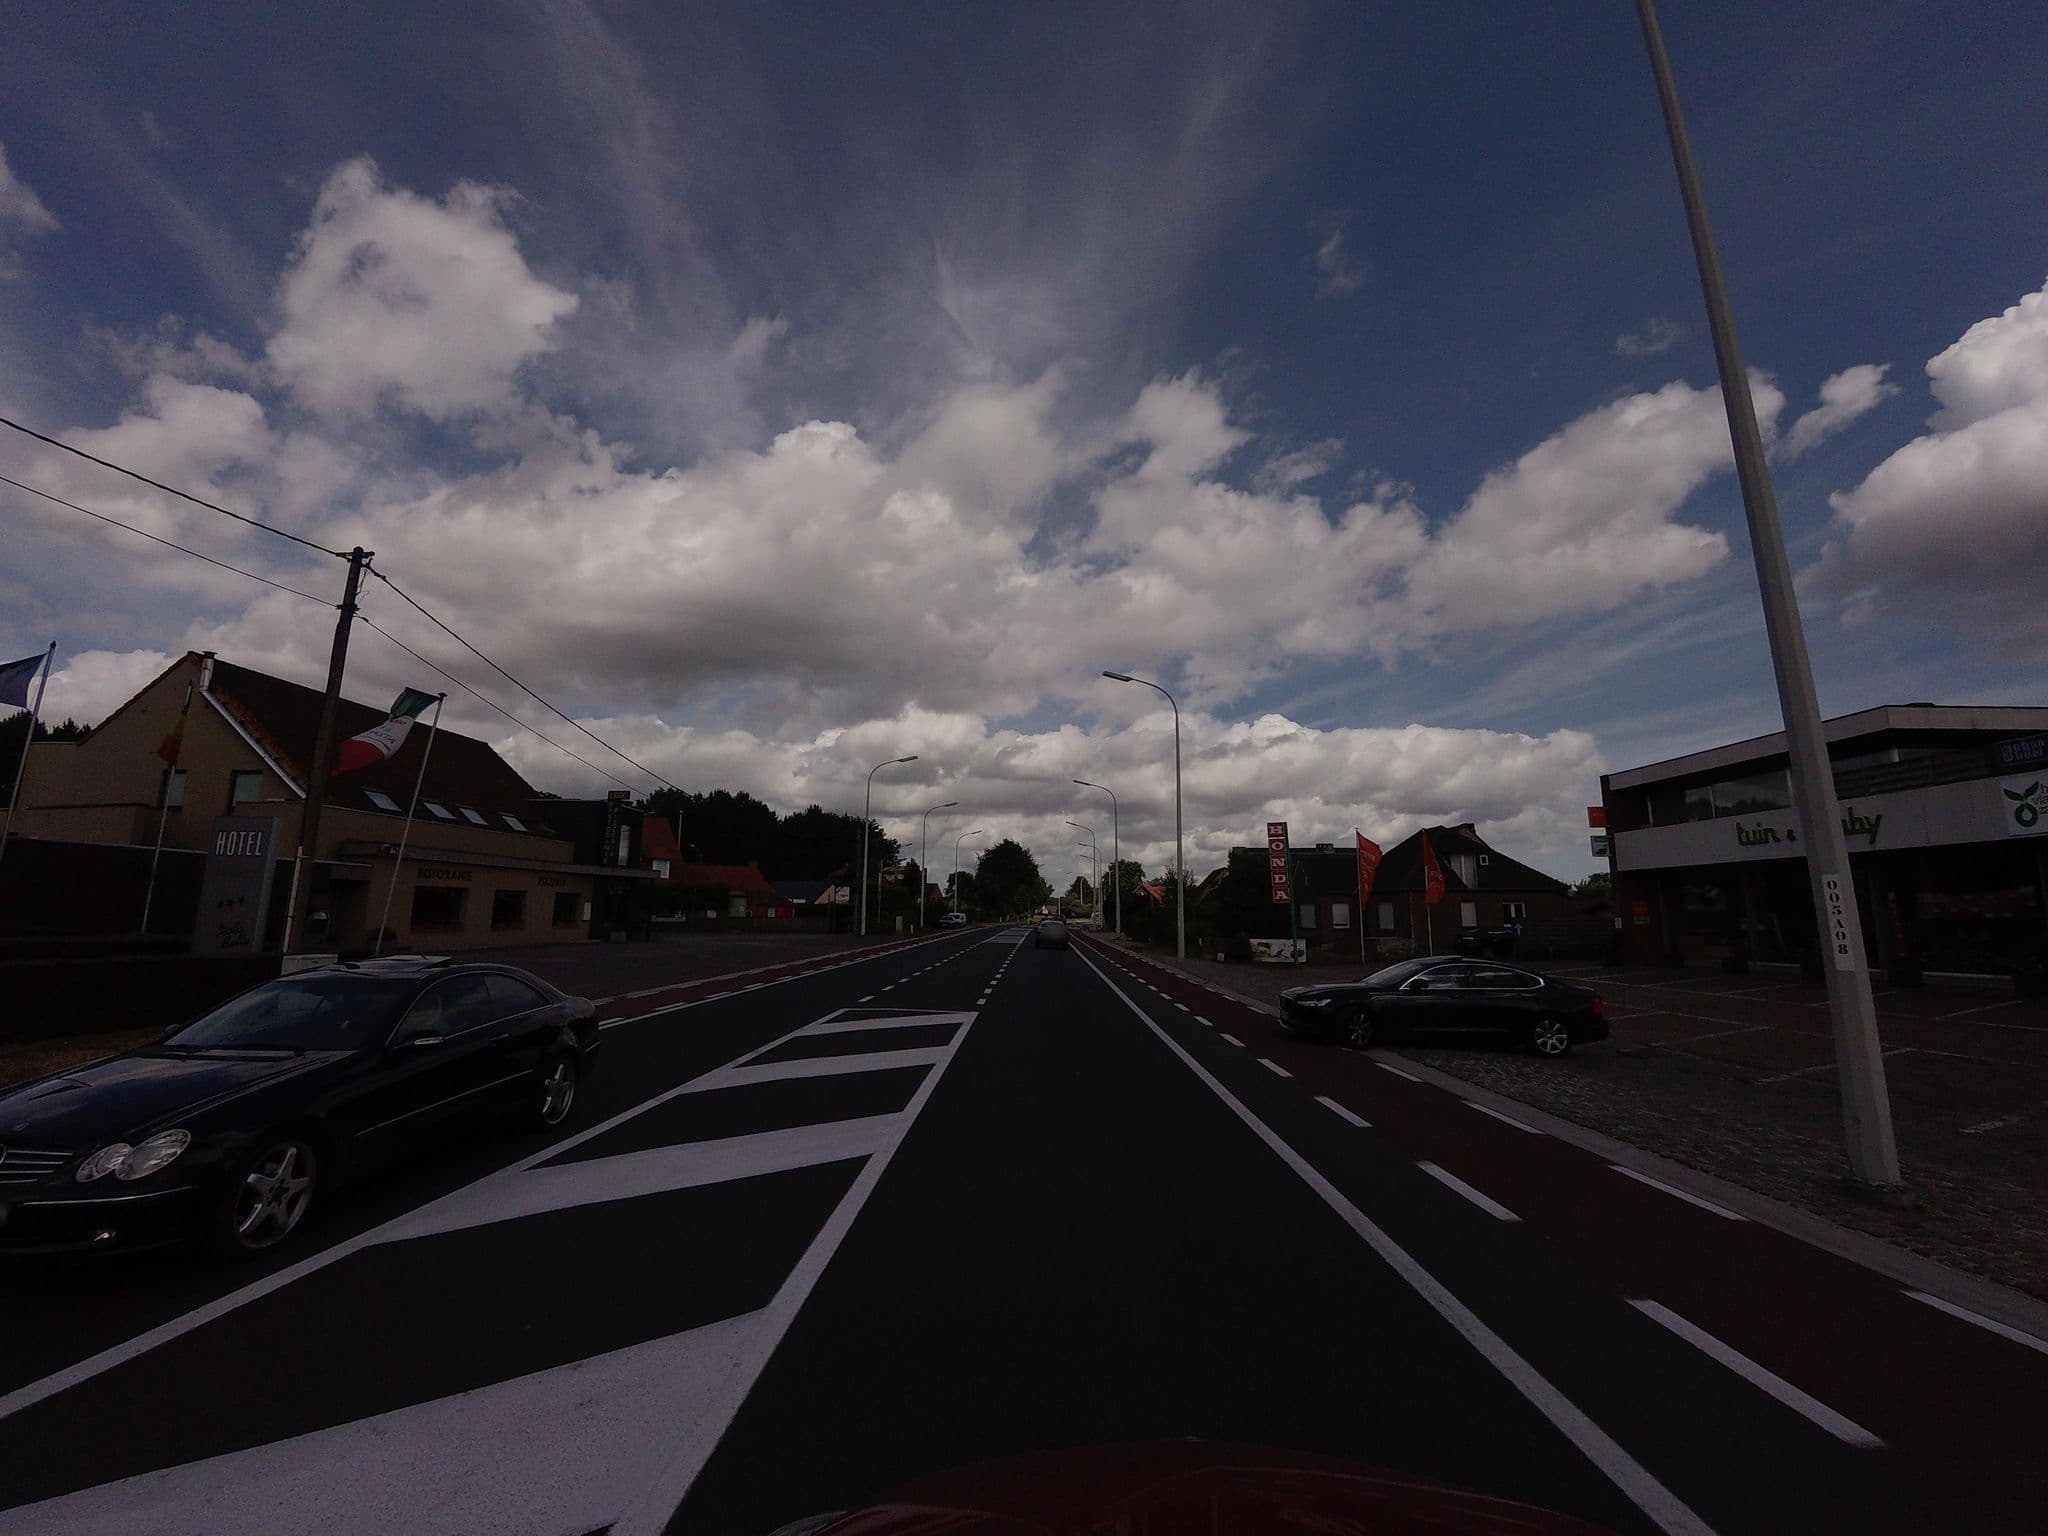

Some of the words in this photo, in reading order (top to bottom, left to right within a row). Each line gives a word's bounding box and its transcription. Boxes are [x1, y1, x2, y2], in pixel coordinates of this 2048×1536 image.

[215, 831, 262, 856] HOTEL
[1735, 822, 1780, 846] tuin
[1268, 825, 1290, 900] HONDA
